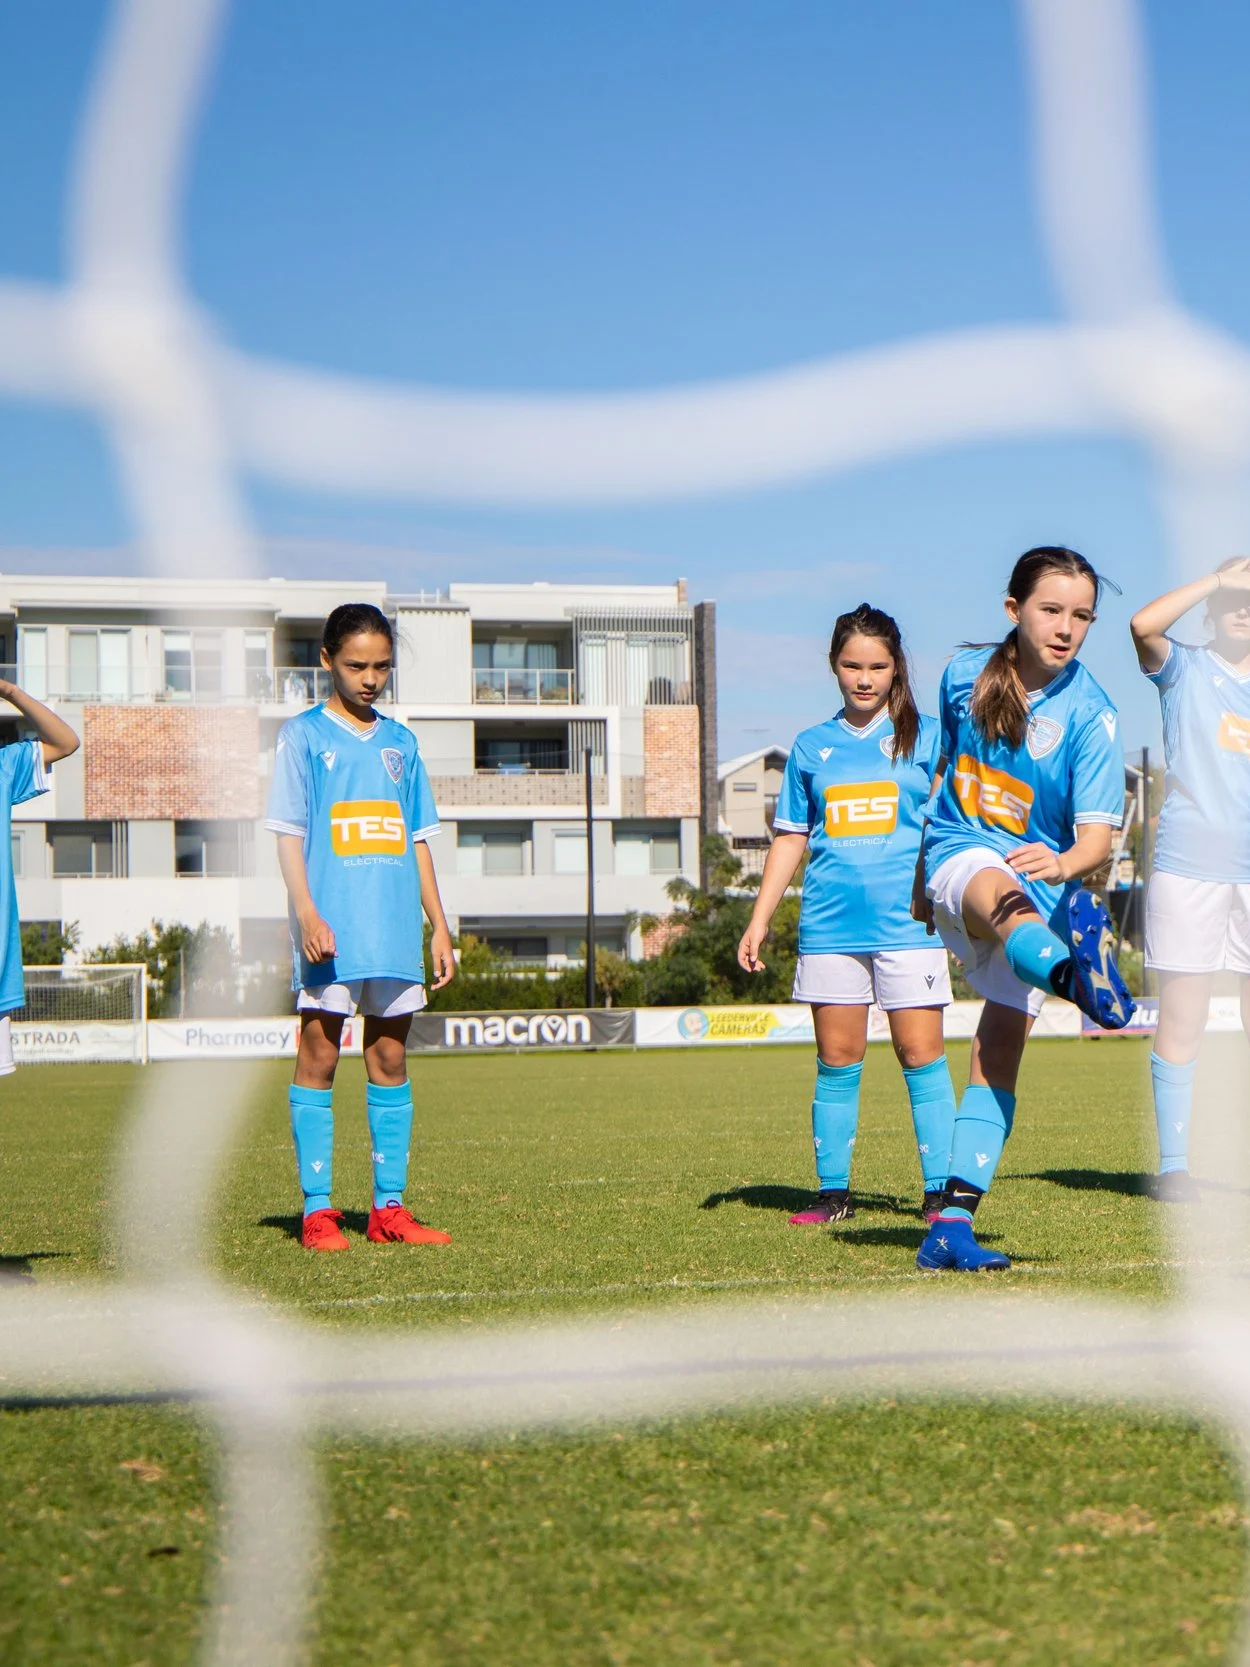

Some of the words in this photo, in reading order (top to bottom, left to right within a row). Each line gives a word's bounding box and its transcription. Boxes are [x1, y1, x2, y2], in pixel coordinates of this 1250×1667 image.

[954, 769, 1032, 820] TES
[826, 796, 899, 824] TES
[331, 815, 405, 842] TES
[832, 837, 893, 848] ELECTRICAL
[343, 857, 404, 867] ELECTRICAL
[185, 1028, 290, 1048] Pharmacy
[445, 1014, 591, 1046] macron
[711, 1023, 766, 1035] CAMERAS
